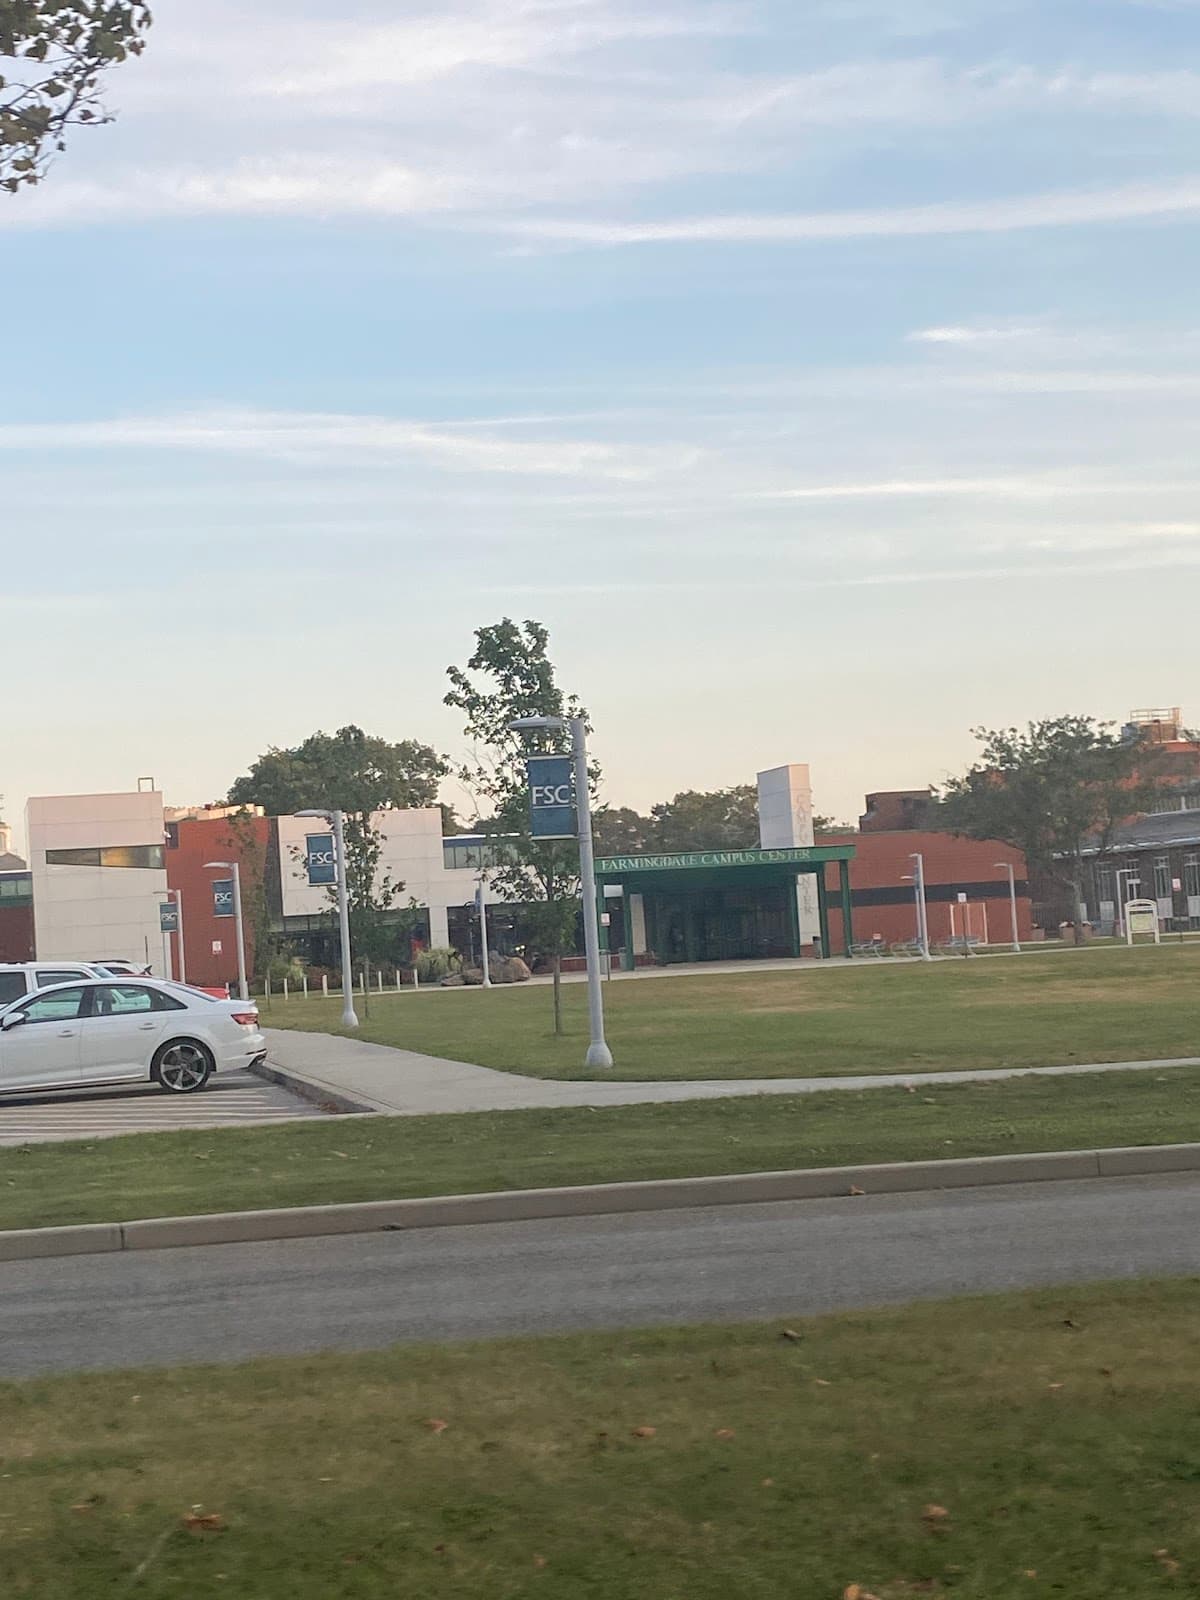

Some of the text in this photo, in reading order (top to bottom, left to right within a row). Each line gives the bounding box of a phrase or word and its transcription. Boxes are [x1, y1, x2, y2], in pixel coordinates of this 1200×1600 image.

[532, 785, 569, 805] FSC
[309, 851, 333, 865] FSC
[602, 848, 811, 870] FARMINGDALE CAMPUS CENTER
[214, 891, 232, 904] FSC
